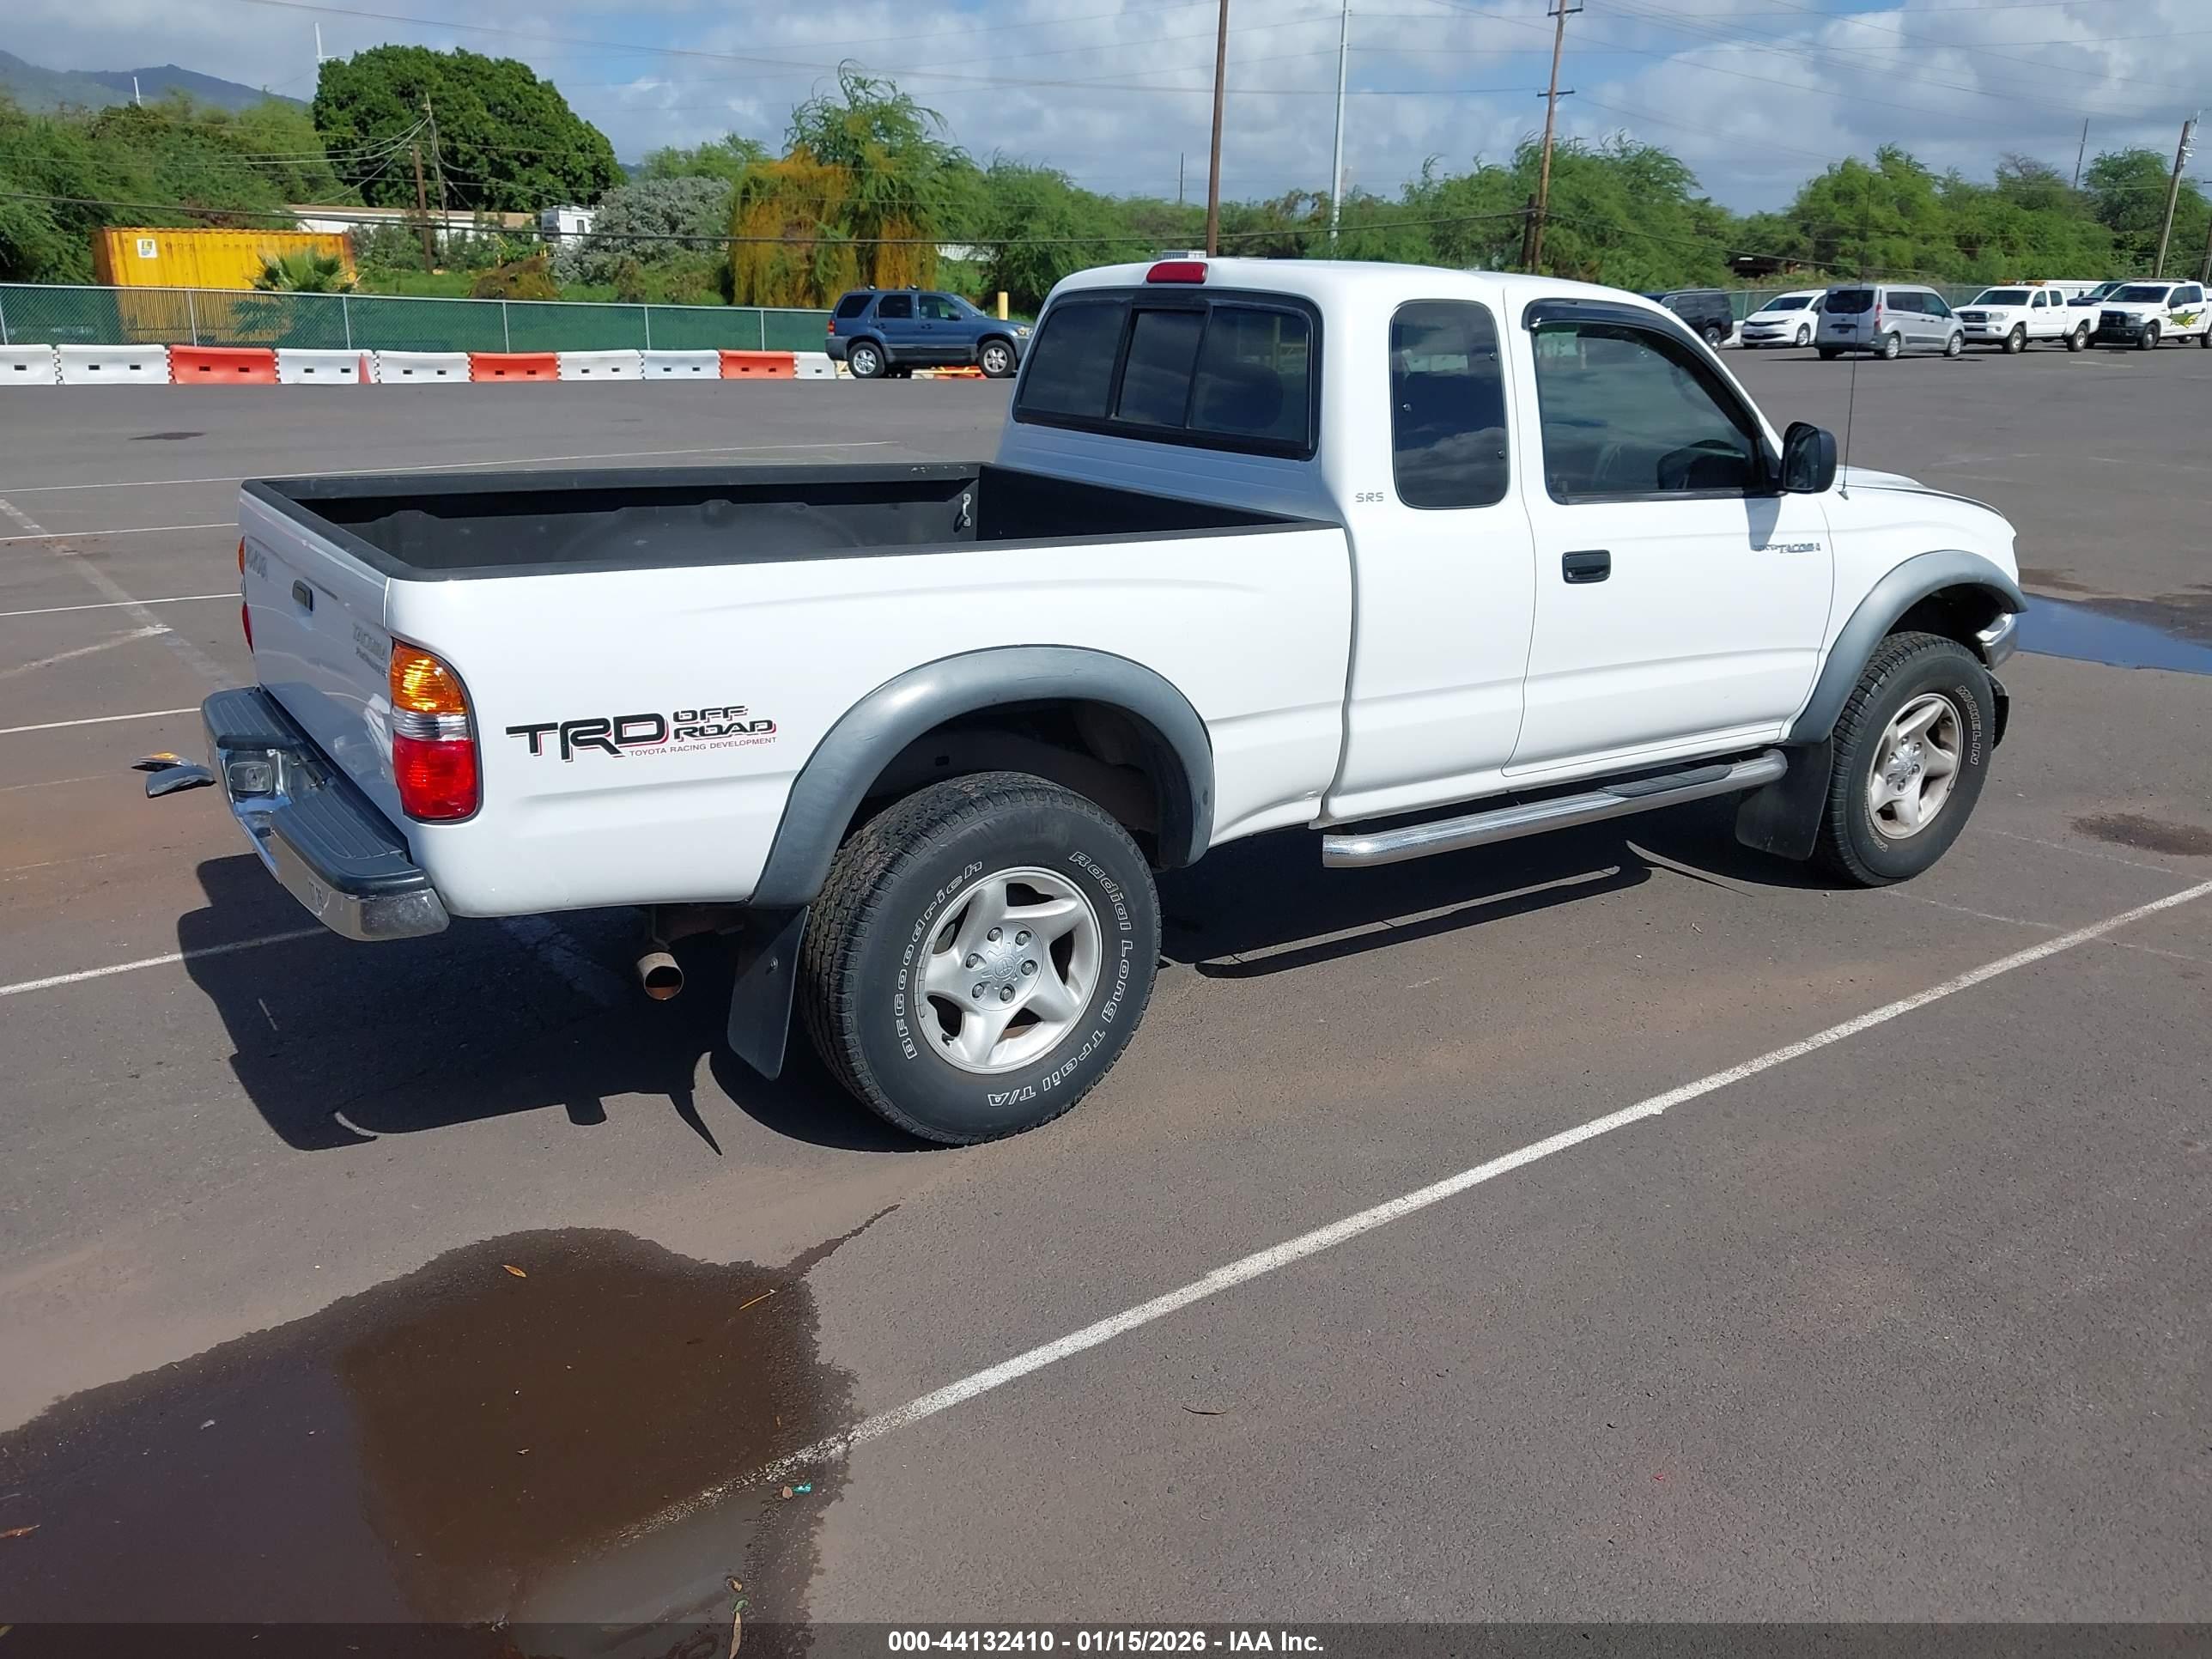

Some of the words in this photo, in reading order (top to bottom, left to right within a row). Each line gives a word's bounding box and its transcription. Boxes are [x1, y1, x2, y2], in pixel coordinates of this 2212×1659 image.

[506, 713, 669, 763] TRD
[673, 706, 749, 724] OFF
[674, 720, 777, 743] ROAD
[1954, 685, 1982, 765] MICHELIN
[629, 747, 667, 757] TOYOTA
[670, 744, 707, 753] RACING
[710, 737, 777, 749] DEVELOPMENT
[1068, 851, 1133, 931] Radial
[894, 860, 982, 1060] BFGoodrich
[1101, 939, 1133, 1024] Long
[1042, 1030, 1106, 1091] Trail
[988, 1085, 1036, 1107] T/A
